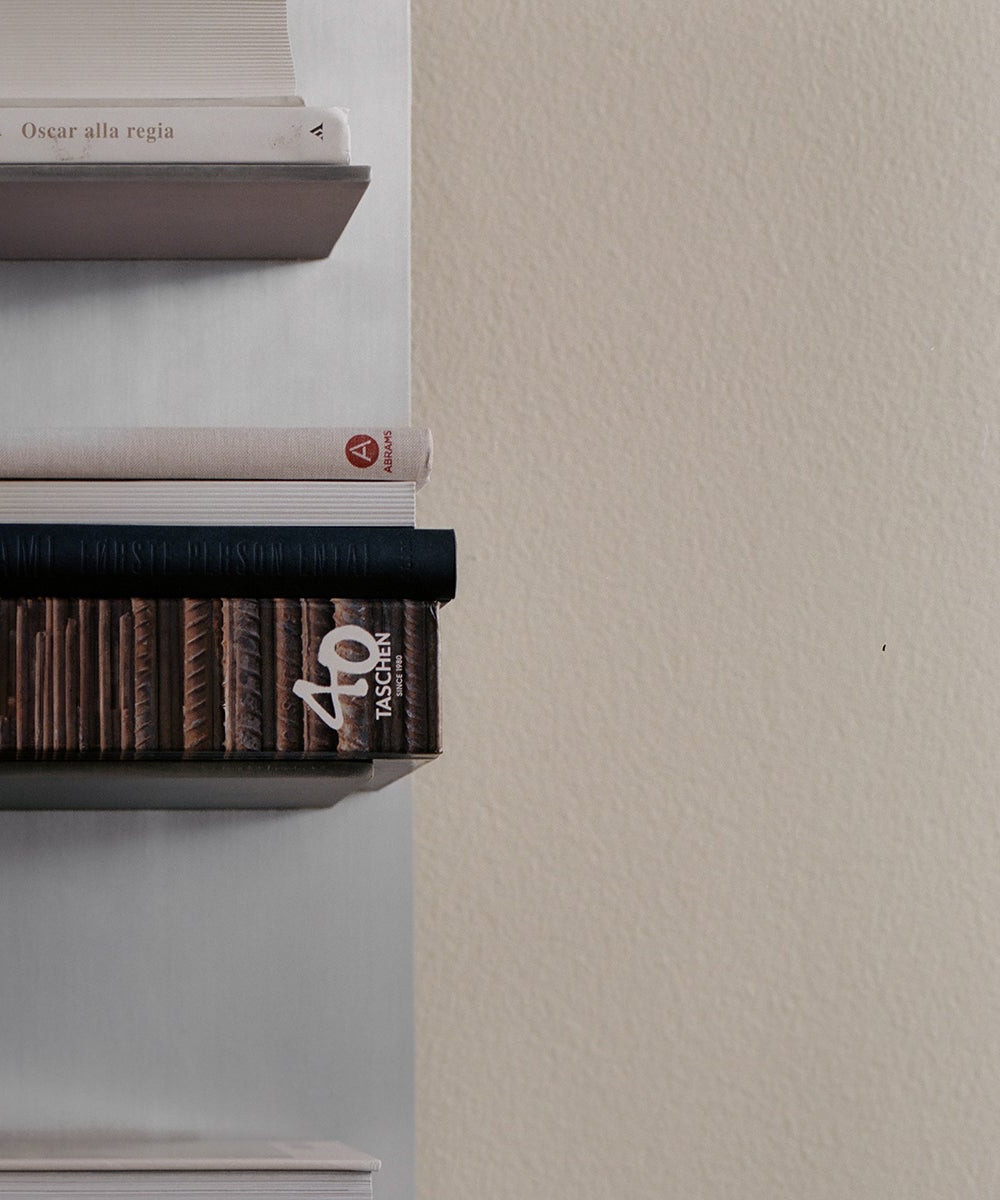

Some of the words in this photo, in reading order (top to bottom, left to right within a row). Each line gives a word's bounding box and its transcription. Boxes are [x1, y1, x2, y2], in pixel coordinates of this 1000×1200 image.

[21, 121, 78, 139] Oscar
[84, 122, 119, 139] alla
[126, 122, 174, 143] regia
[383, 430, 393, 473] ABRAMS
[292, 624, 380, 731] 40
[375, 632, 392, 720] TASCHEN
[395, 654, 403, 671] 1980
[395, 673, 403, 697] SINCE
